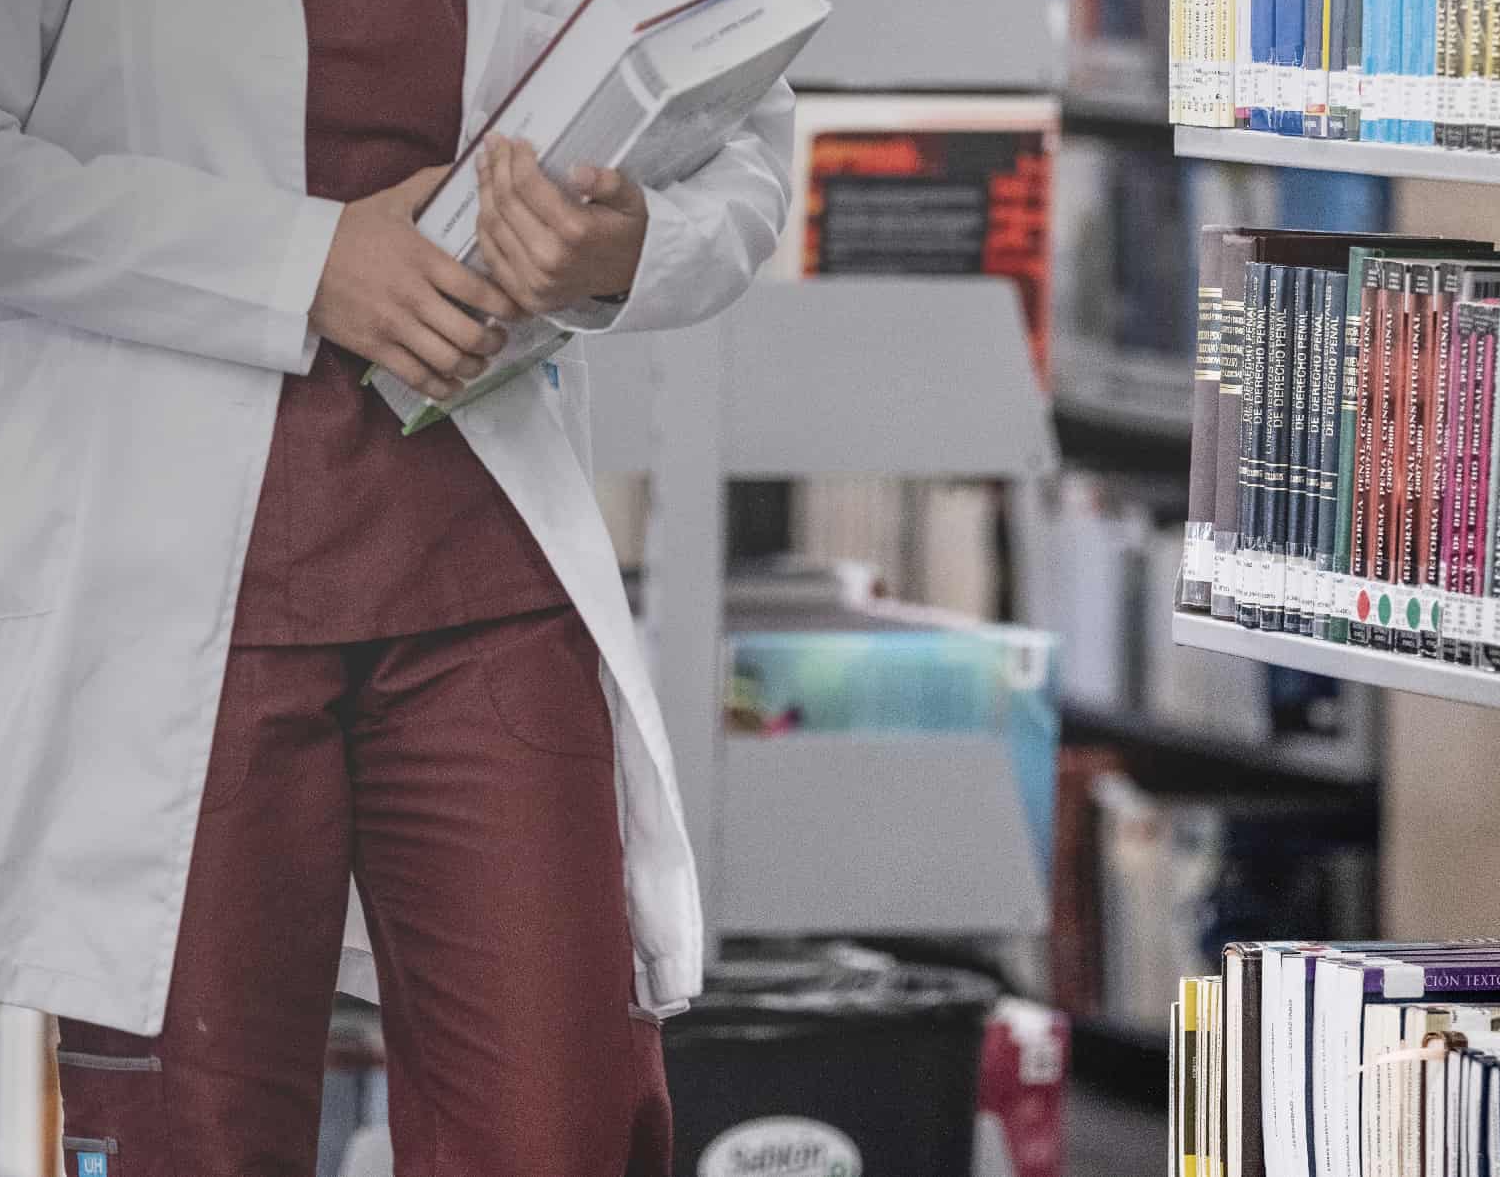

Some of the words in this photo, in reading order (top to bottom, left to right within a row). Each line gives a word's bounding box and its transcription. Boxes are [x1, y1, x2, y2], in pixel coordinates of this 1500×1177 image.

[1256, 306, 1267, 343] PENAL
[1276, 309, 1287, 346] PENAL
[1298, 311, 1308, 348] PENAL
[1313, 314, 1323, 351] PENAL
[1328, 316, 1339, 354] PENAL
[1254, 348, 1265, 404] DERECHO
[1275, 350, 1286, 406] DERECHO
[1296, 353, 1307, 408] DERECHO
[1360, 306, 1372, 437] CONSTITUCIONAL
[1381, 308, 1393, 441] CONSTITUCIONAL
[1409, 313, 1421, 445] CONSTITUCIONAL
[1435, 311, 1449, 444] CONSTITUCIONAL
[1460, 339, 1470, 382] PENAL
[1475, 337, 1486, 380] PENAL
[1311, 356, 1322, 411] DERECHO
[1326, 359, 1337, 414] DERECHO
[1253, 408, 1263, 424] DE
[1274, 411, 1283, 428] DE
[1296, 414, 1305, 430] DE
[1311, 417, 1320, 432] DE
[1325, 421, 1334, 436] DE
[1455, 390, 1468, 457] PROCESAL
[1471, 388, 1483, 455] PROCESAL
[1357, 447, 1367, 492] PENAL
[1378, 450, 1388, 495] PENAL
[1406, 454, 1416, 499] PENAL
[1432, 453, 1442, 498] PENAL
[1453, 464, 1464, 526] DERECHO
[1468, 461, 1480, 524] DERECHO
[1354, 499, 1364, 572] REFORMA
[1375, 503, 1385, 576] REFORMA
[1403, 508, 1413, 580] REFORMA
[1428, 507, 1439, 580] REFORMA
[1452, 535, 1461, 550] DE
[1467, 533, 1476, 548] DE
